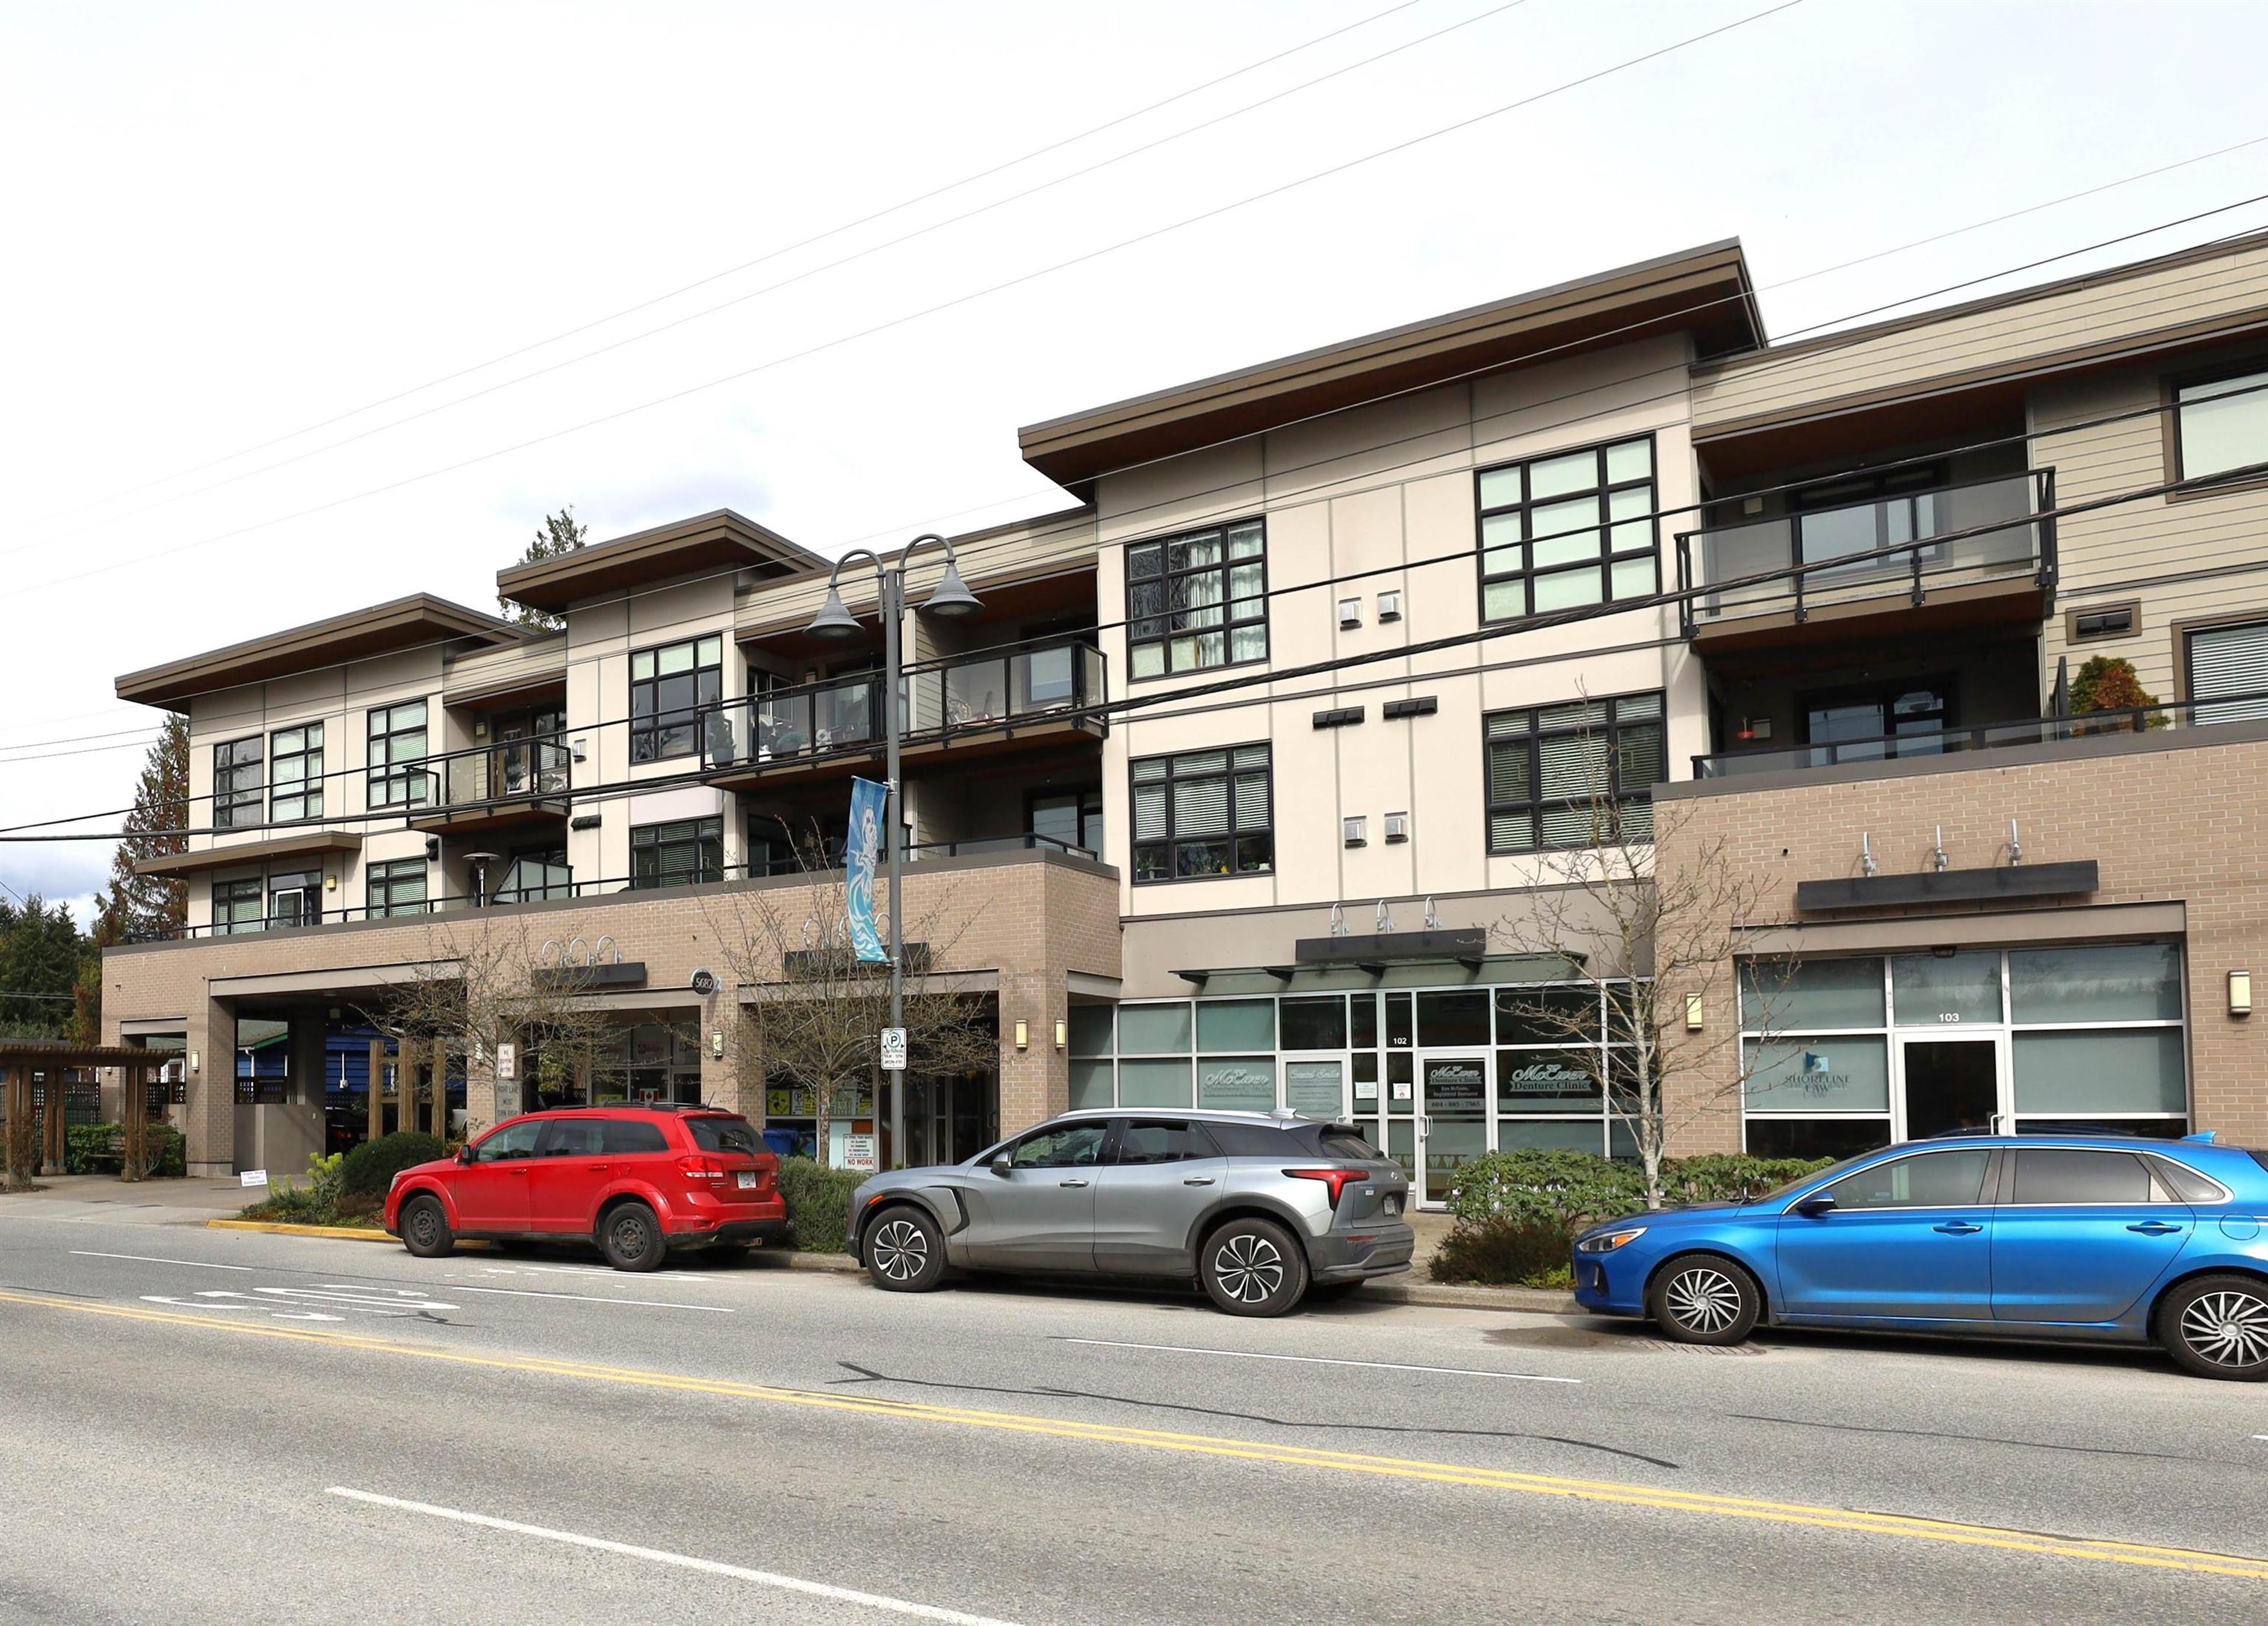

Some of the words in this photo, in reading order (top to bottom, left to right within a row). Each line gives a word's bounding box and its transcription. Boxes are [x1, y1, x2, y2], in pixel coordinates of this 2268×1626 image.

[696, 977, 713, 989] 5682
[1938, 1013, 1960, 1022] 103
[1514, 1081, 1555, 1090] Denture
[1556, 1081, 1588, 1090] Clinic
